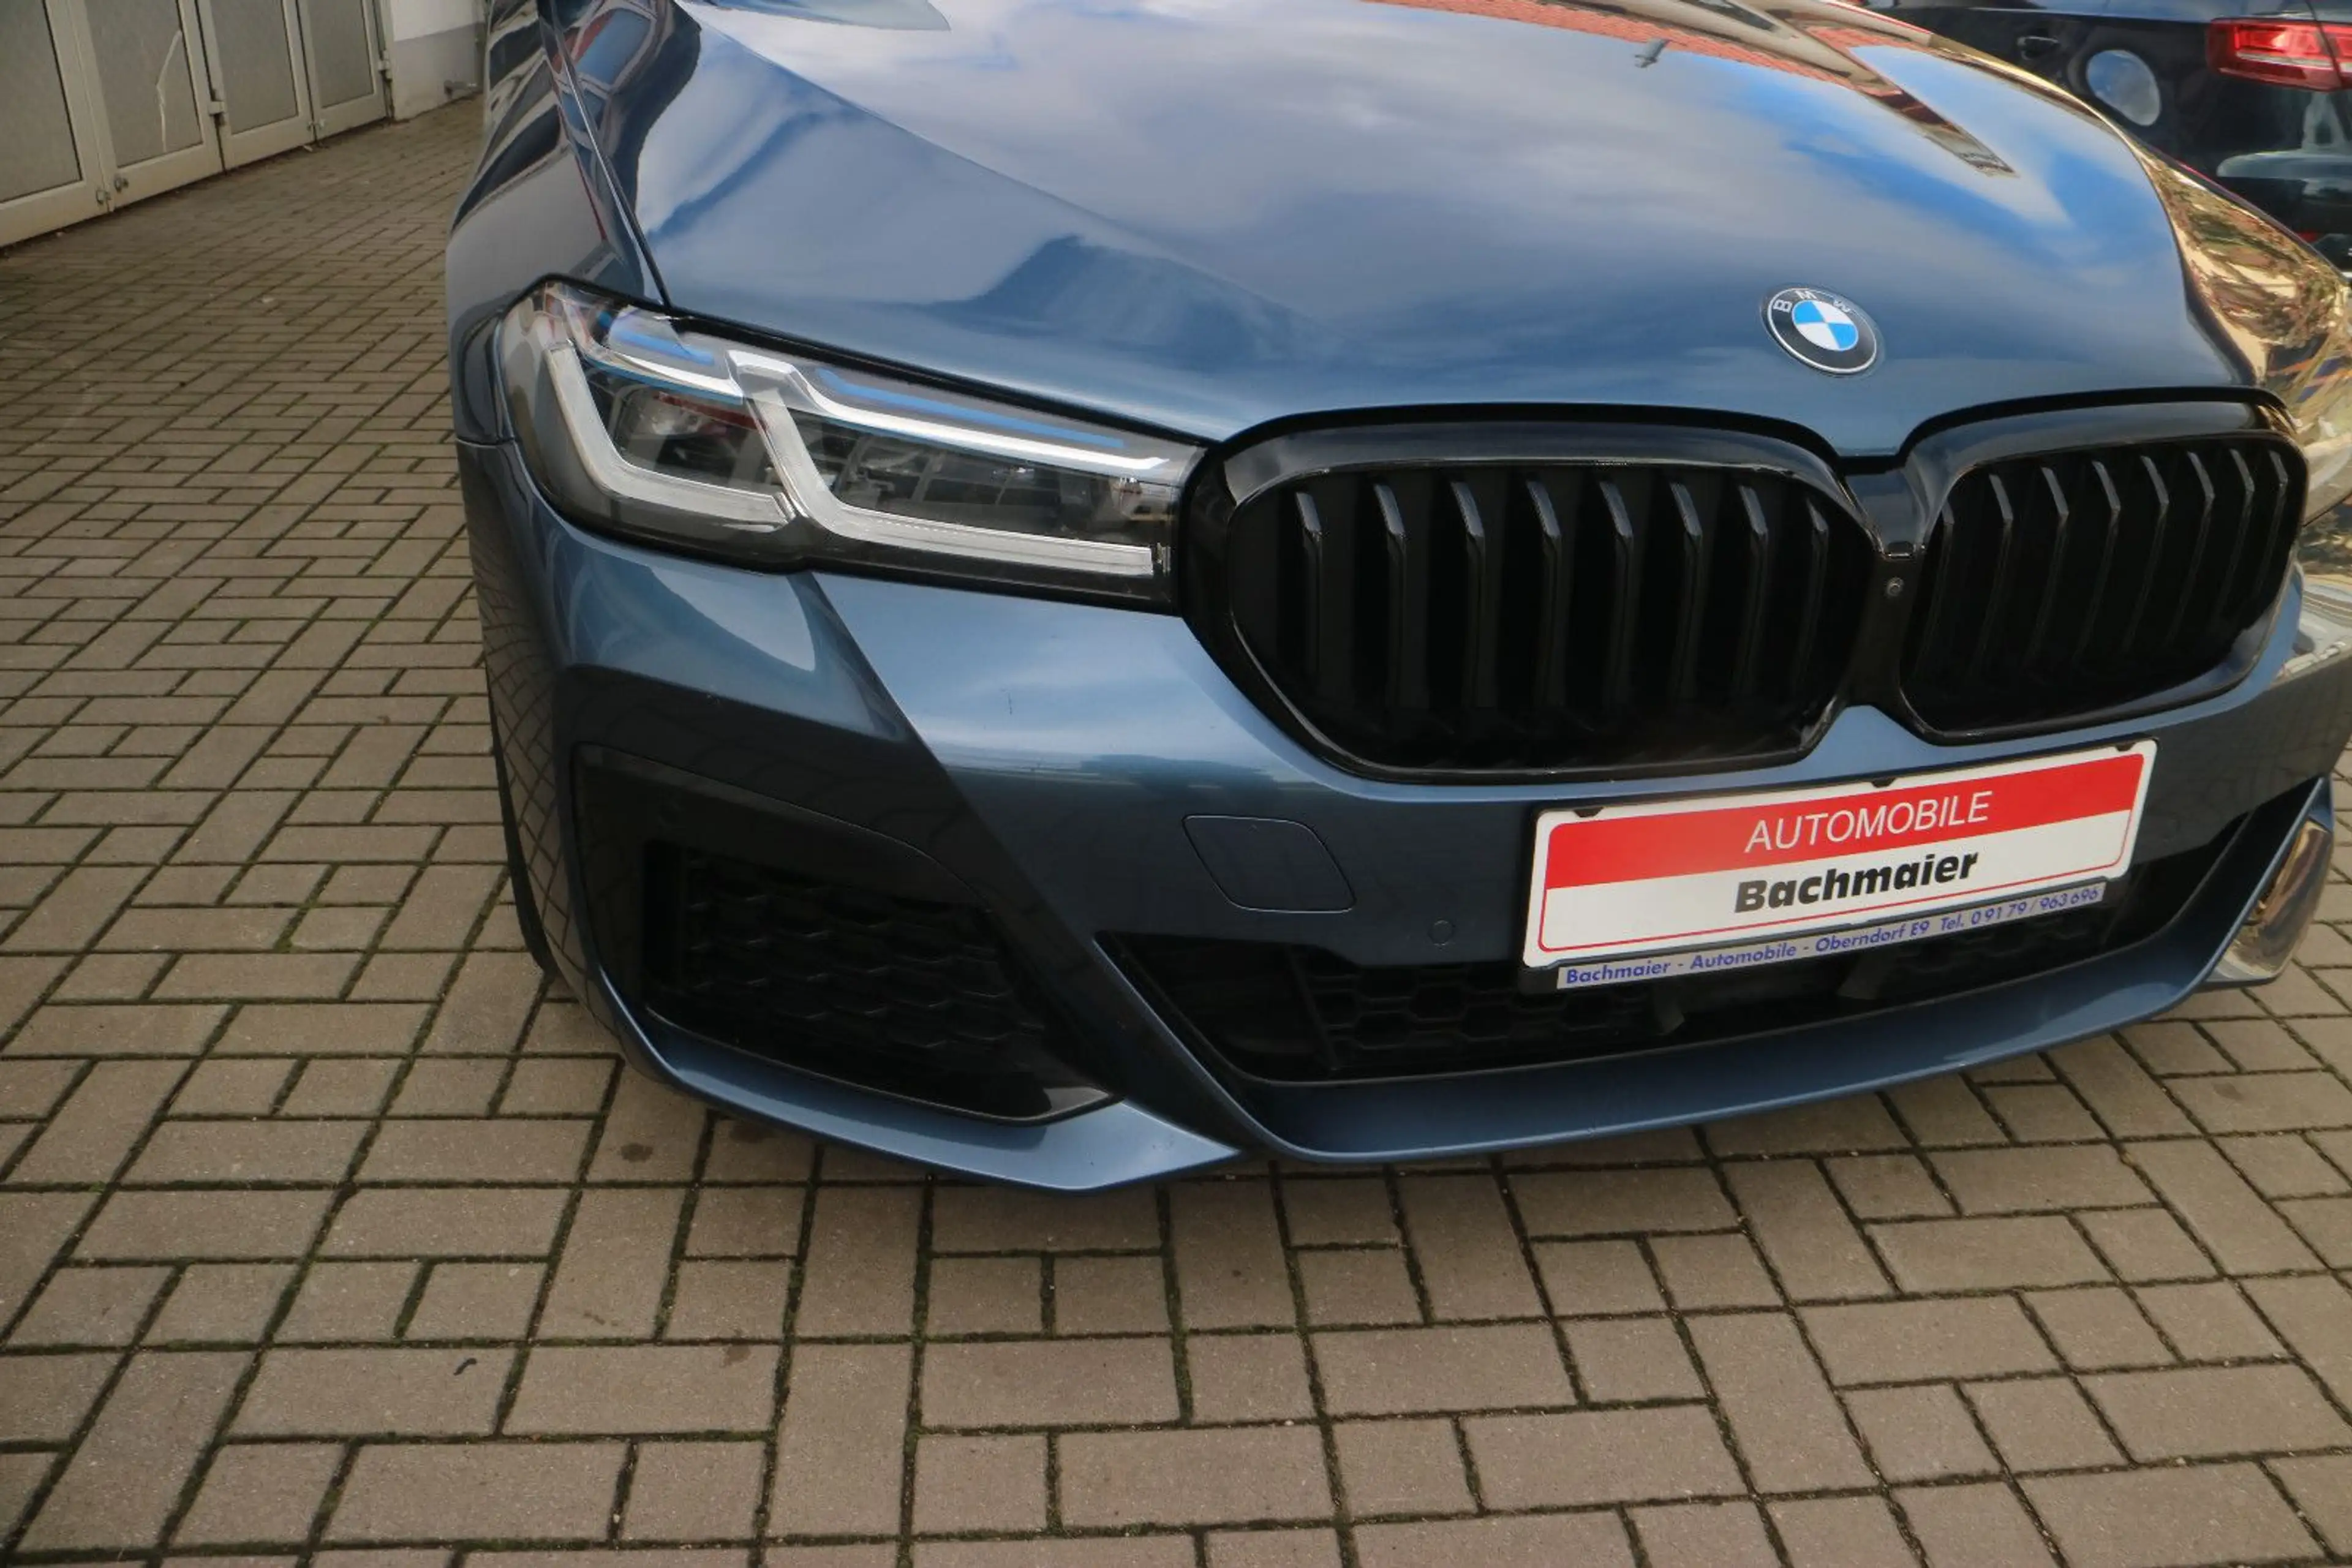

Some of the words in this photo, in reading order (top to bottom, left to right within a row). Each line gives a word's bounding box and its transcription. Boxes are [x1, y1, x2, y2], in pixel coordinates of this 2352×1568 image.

[1773, 290, 1850, 313] BMW
[1744, 791, 1992, 853] AUTOMOBILE
[1734, 852, 1979, 913] Bachmaier
[1566, 959, 1671, 984] Bachmaier
[1690, 943, 1796, 970] Automobile
[1815, 926, 1905, 952] Oberndorf
[1940, 914, 1964, 931] Tel.
